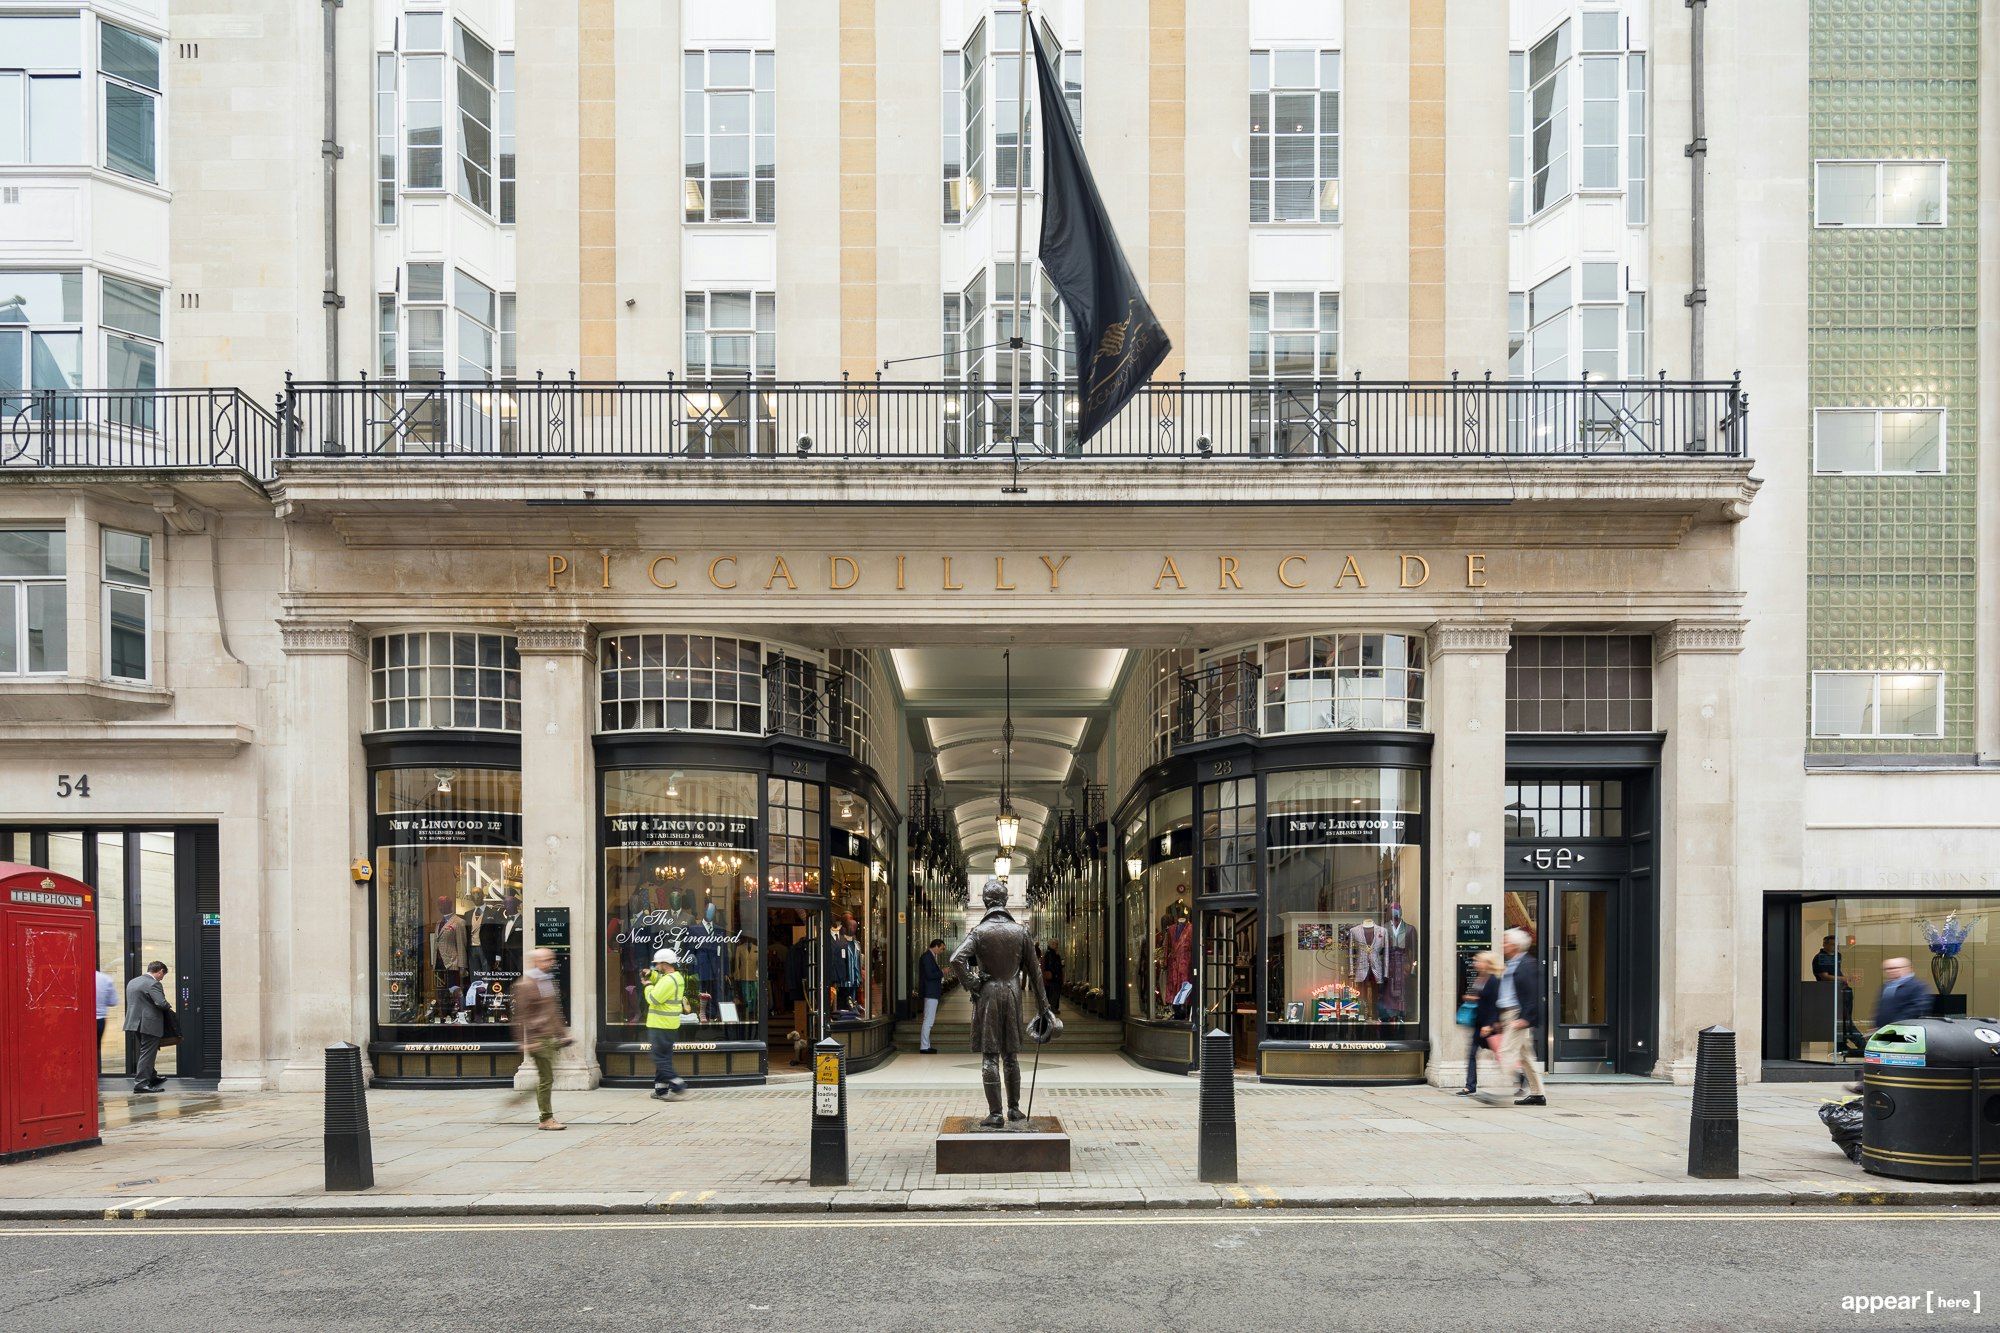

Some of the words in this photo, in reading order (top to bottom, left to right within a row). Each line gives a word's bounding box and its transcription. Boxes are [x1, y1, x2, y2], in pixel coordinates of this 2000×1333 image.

[547, 554, 1071, 590] PICCADILLY
[1154, 554, 1488, 590] ARCADE
[792, 760, 808, 776] 24
[1214, 760, 1232, 776] 23
[57, 774, 91, 798] 54
[389, 819, 410, 830] NEW
[412, 821, 419, 830] &
[421, 818, 483, 830] LINGWOOD
[612, 819, 638, 831] NEW
[641, 821, 649, 831] &
[653, 818, 725, 832] LINGWOOD
[1290, 820, 1316, 832] NEW
[1319, 821, 1326, 830] &
[1329, 818, 1389, 830] LINGWOOD
[1536, 847, 1572, 869] 52
[13, 890, 80, 906] TELEPHONE
[643, 909, 674, 926] The
[616, 927, 652, 944] New
[652, 930, 670, 949] &
[668, 926, 742, 949] Lingwood
